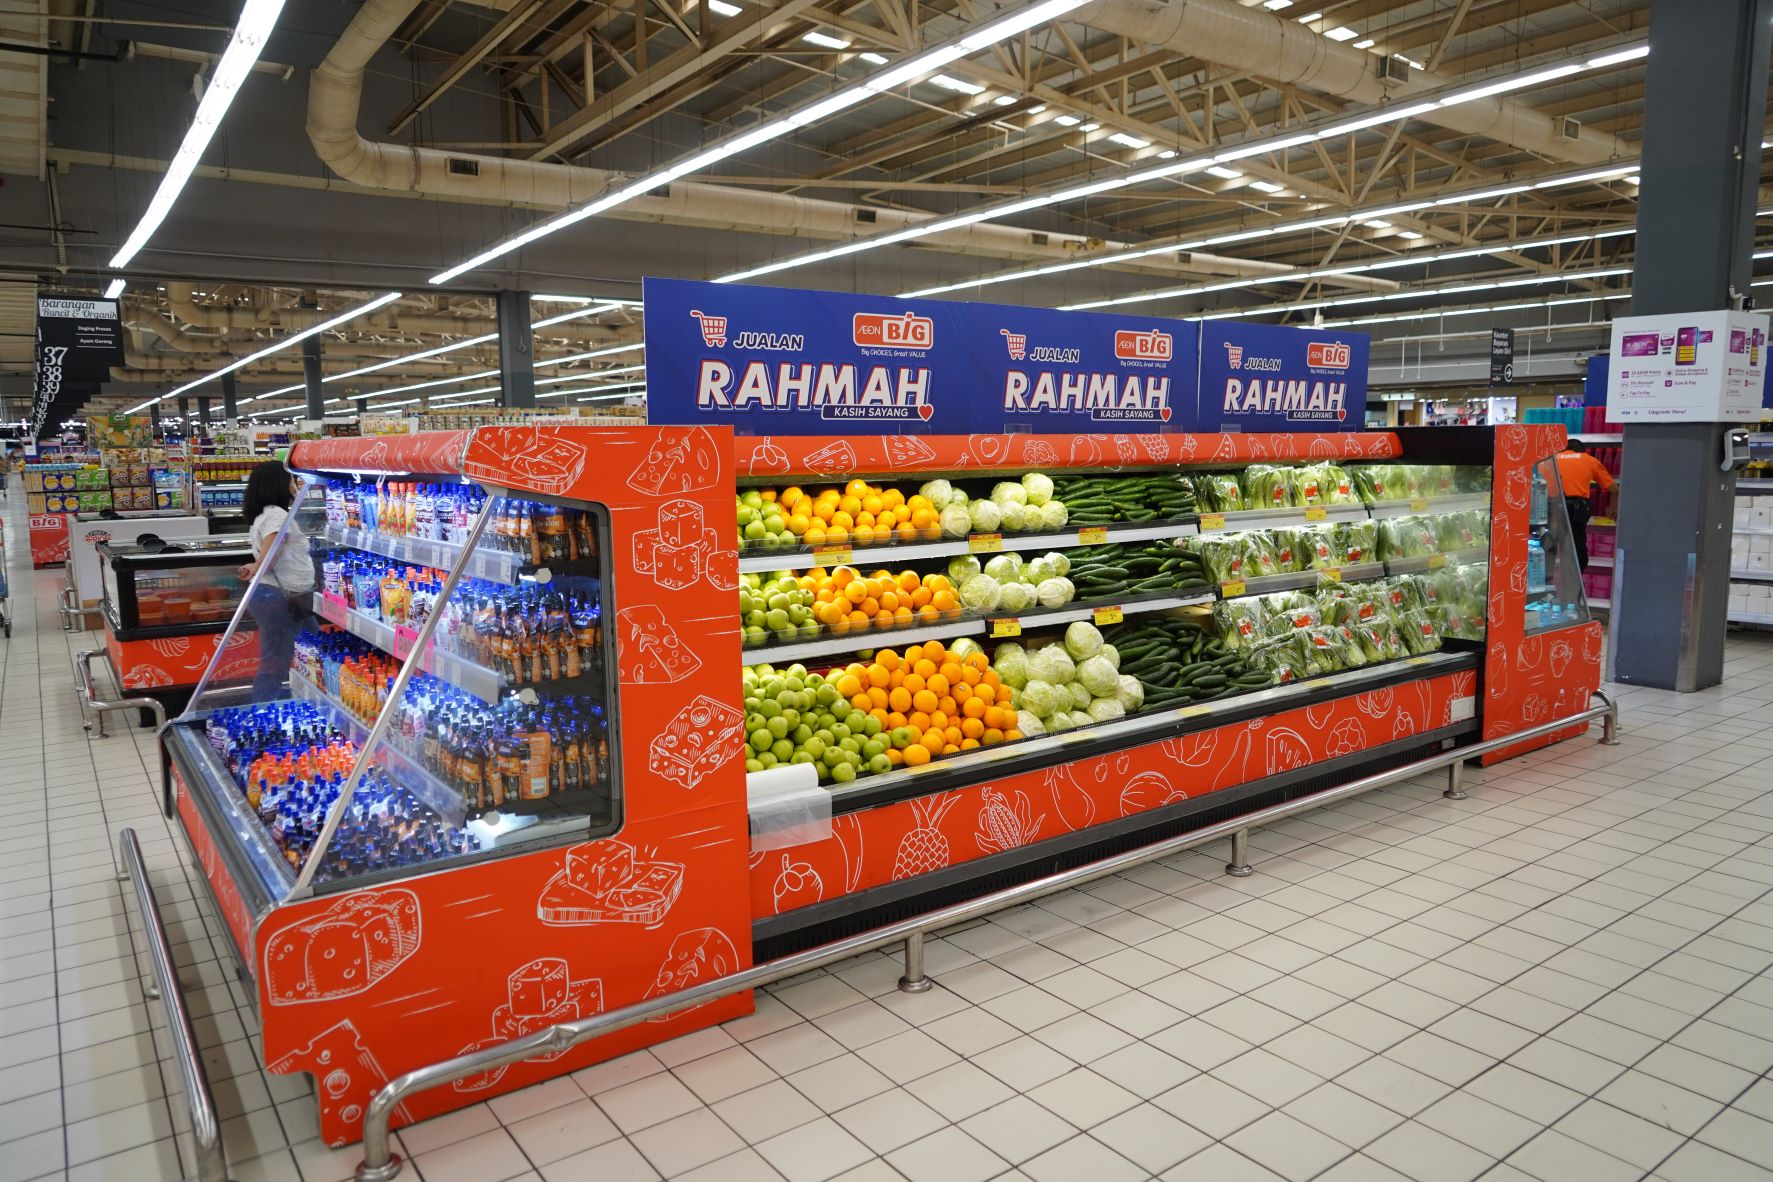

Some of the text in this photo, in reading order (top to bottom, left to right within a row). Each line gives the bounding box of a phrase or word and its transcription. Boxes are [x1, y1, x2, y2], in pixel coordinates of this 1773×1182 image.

[41, 299, 95, 310] Barangan
[42, 308, 117, 319] Runcit & Organik
[734, 332, 803, 350] JUALAN
[44, 346, 68, 366] 37
[1030, 348, 1080, 363] JUALAN
[1244, 357, 1281, 371] JUALAN
[42, 366, 62, 382] 38
[42, 382, 60, 394] 39
[697, 360, 931, 408] RAHMAH
[1004, 370, 1170, 412] RAHMAH
[1224, 377, 1346, 413] RAHMAH
[834, 405, 908, 417] KASIH SAYANG
